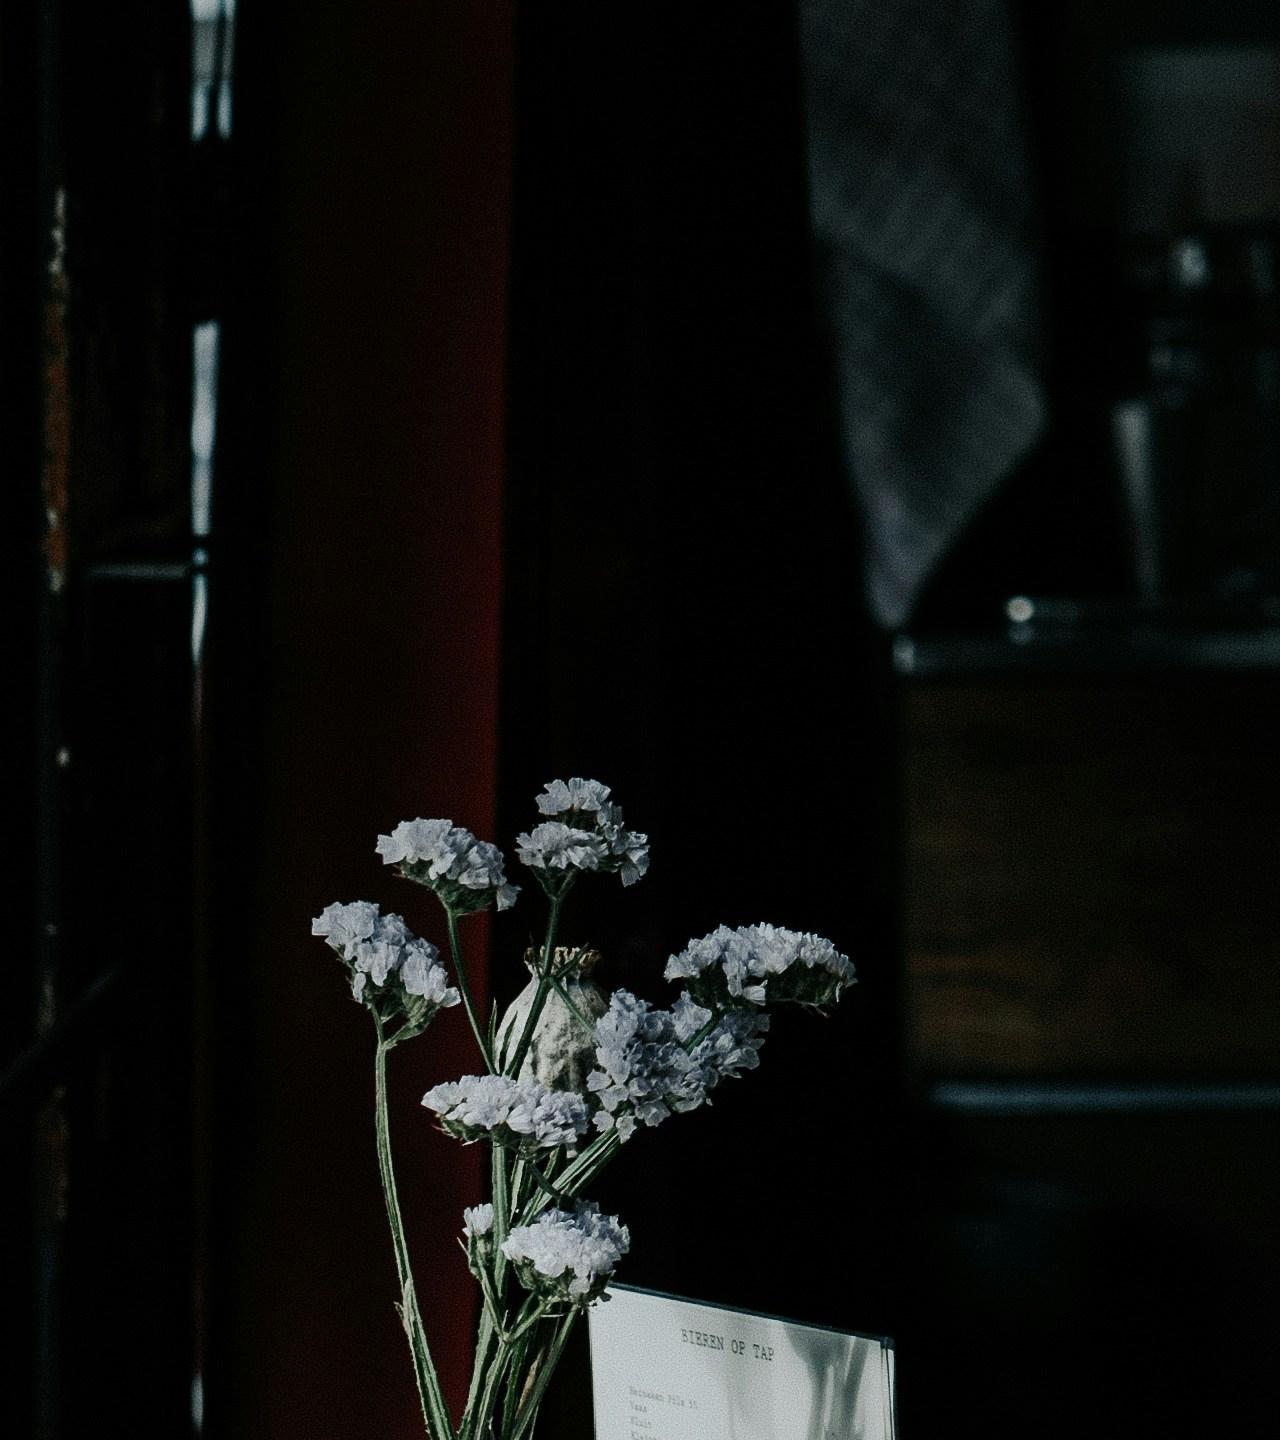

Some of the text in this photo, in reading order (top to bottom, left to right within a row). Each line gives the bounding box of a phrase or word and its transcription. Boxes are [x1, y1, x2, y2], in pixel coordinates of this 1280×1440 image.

[681, 1328, 775, 1362] BIEREN OP TAP
